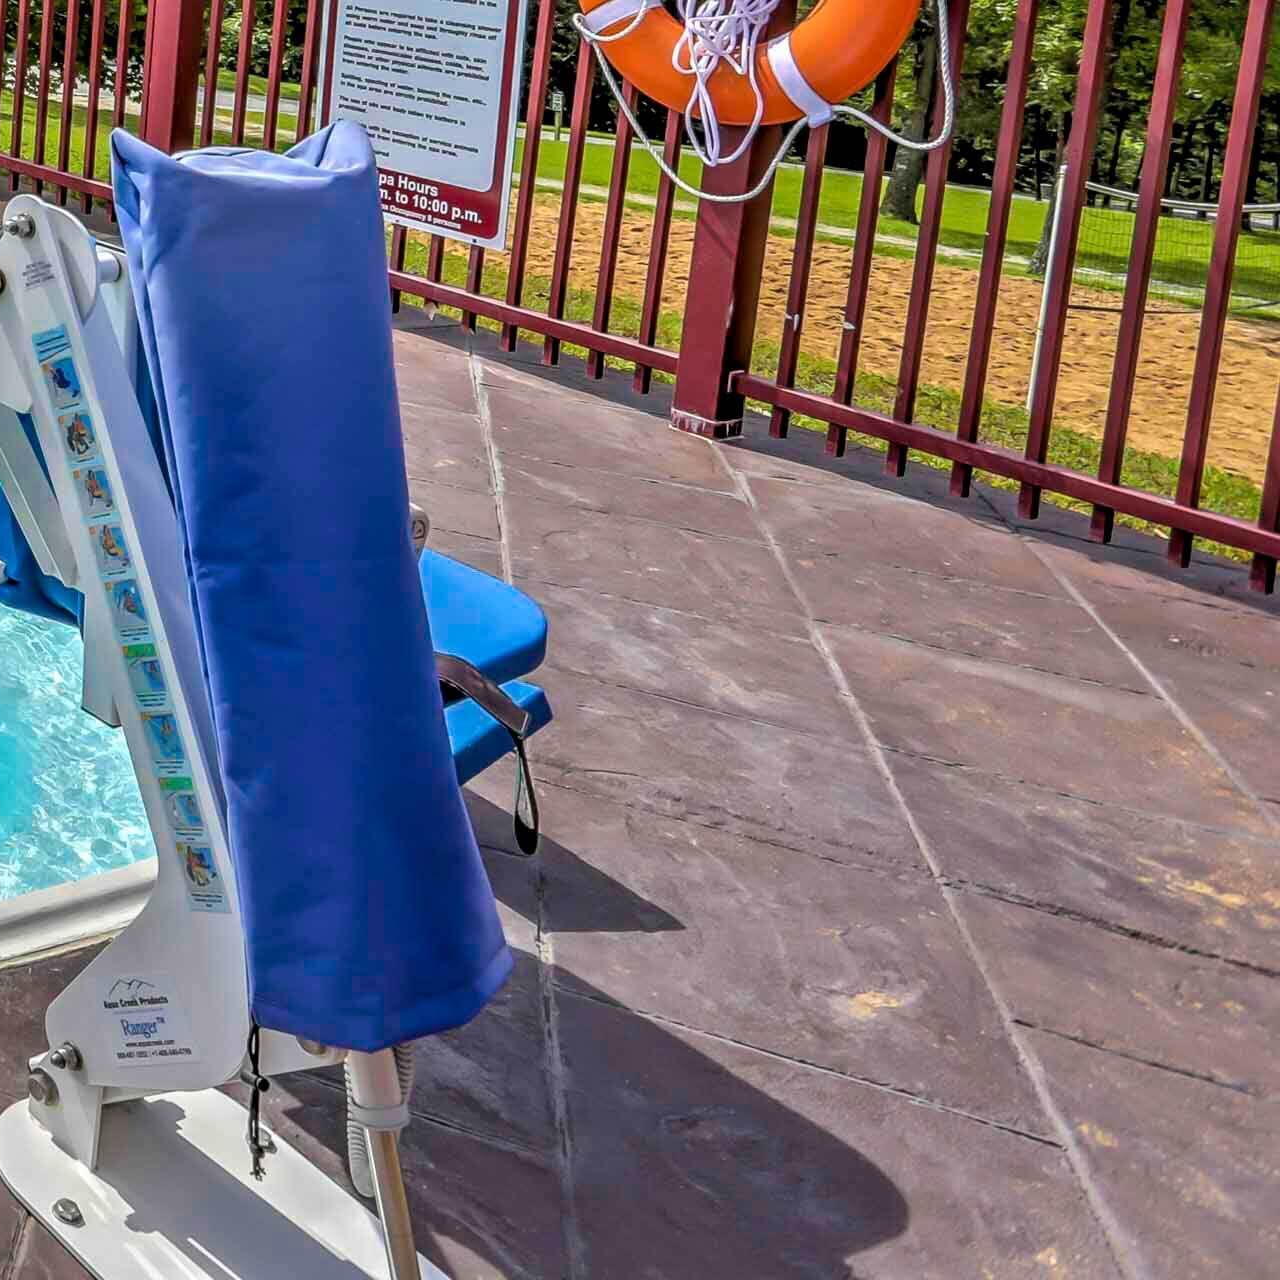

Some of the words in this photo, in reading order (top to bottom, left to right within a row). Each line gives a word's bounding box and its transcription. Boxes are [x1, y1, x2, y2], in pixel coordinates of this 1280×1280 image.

[378, 173, 394, 186] pa
[398, 175, 438, 197] Hours
[395, 190, 408, 204] to
[412, 194, 448, 214] 10:00
[451, 207, 482, 224] p.m.
[139, 996, 168, 1007] Products
